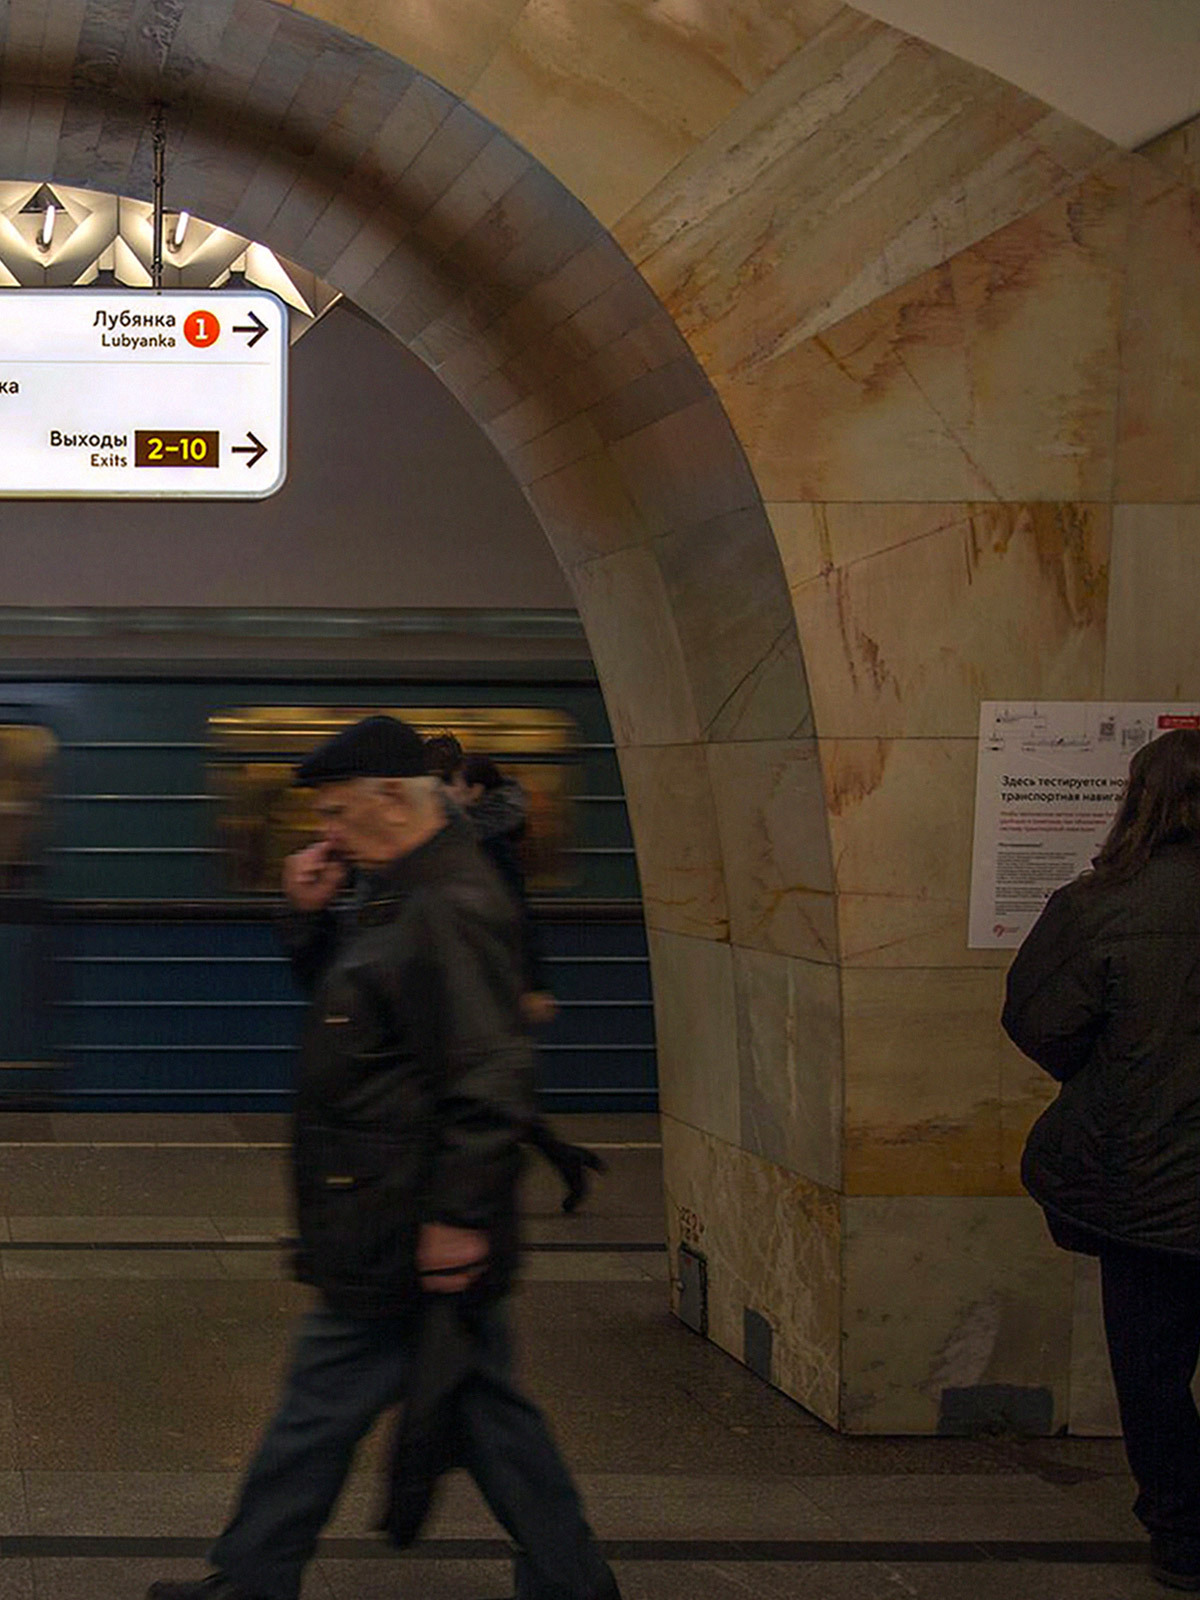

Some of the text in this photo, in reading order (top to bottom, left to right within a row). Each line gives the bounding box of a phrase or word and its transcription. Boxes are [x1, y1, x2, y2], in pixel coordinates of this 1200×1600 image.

[92, 311, 177, 331] Лубянка
[194, 319, 209, 340] 1
[101, 332, 176, 350] Lubyanka
[50, 431, 128, 450] Выходы
[90, 453, 128, 468] Exits
[1001, 776, 1035, 788] Здесь
[1037, 777, 1107, 790] тестируется
[1001, 792, 1080, 805] транспортная
